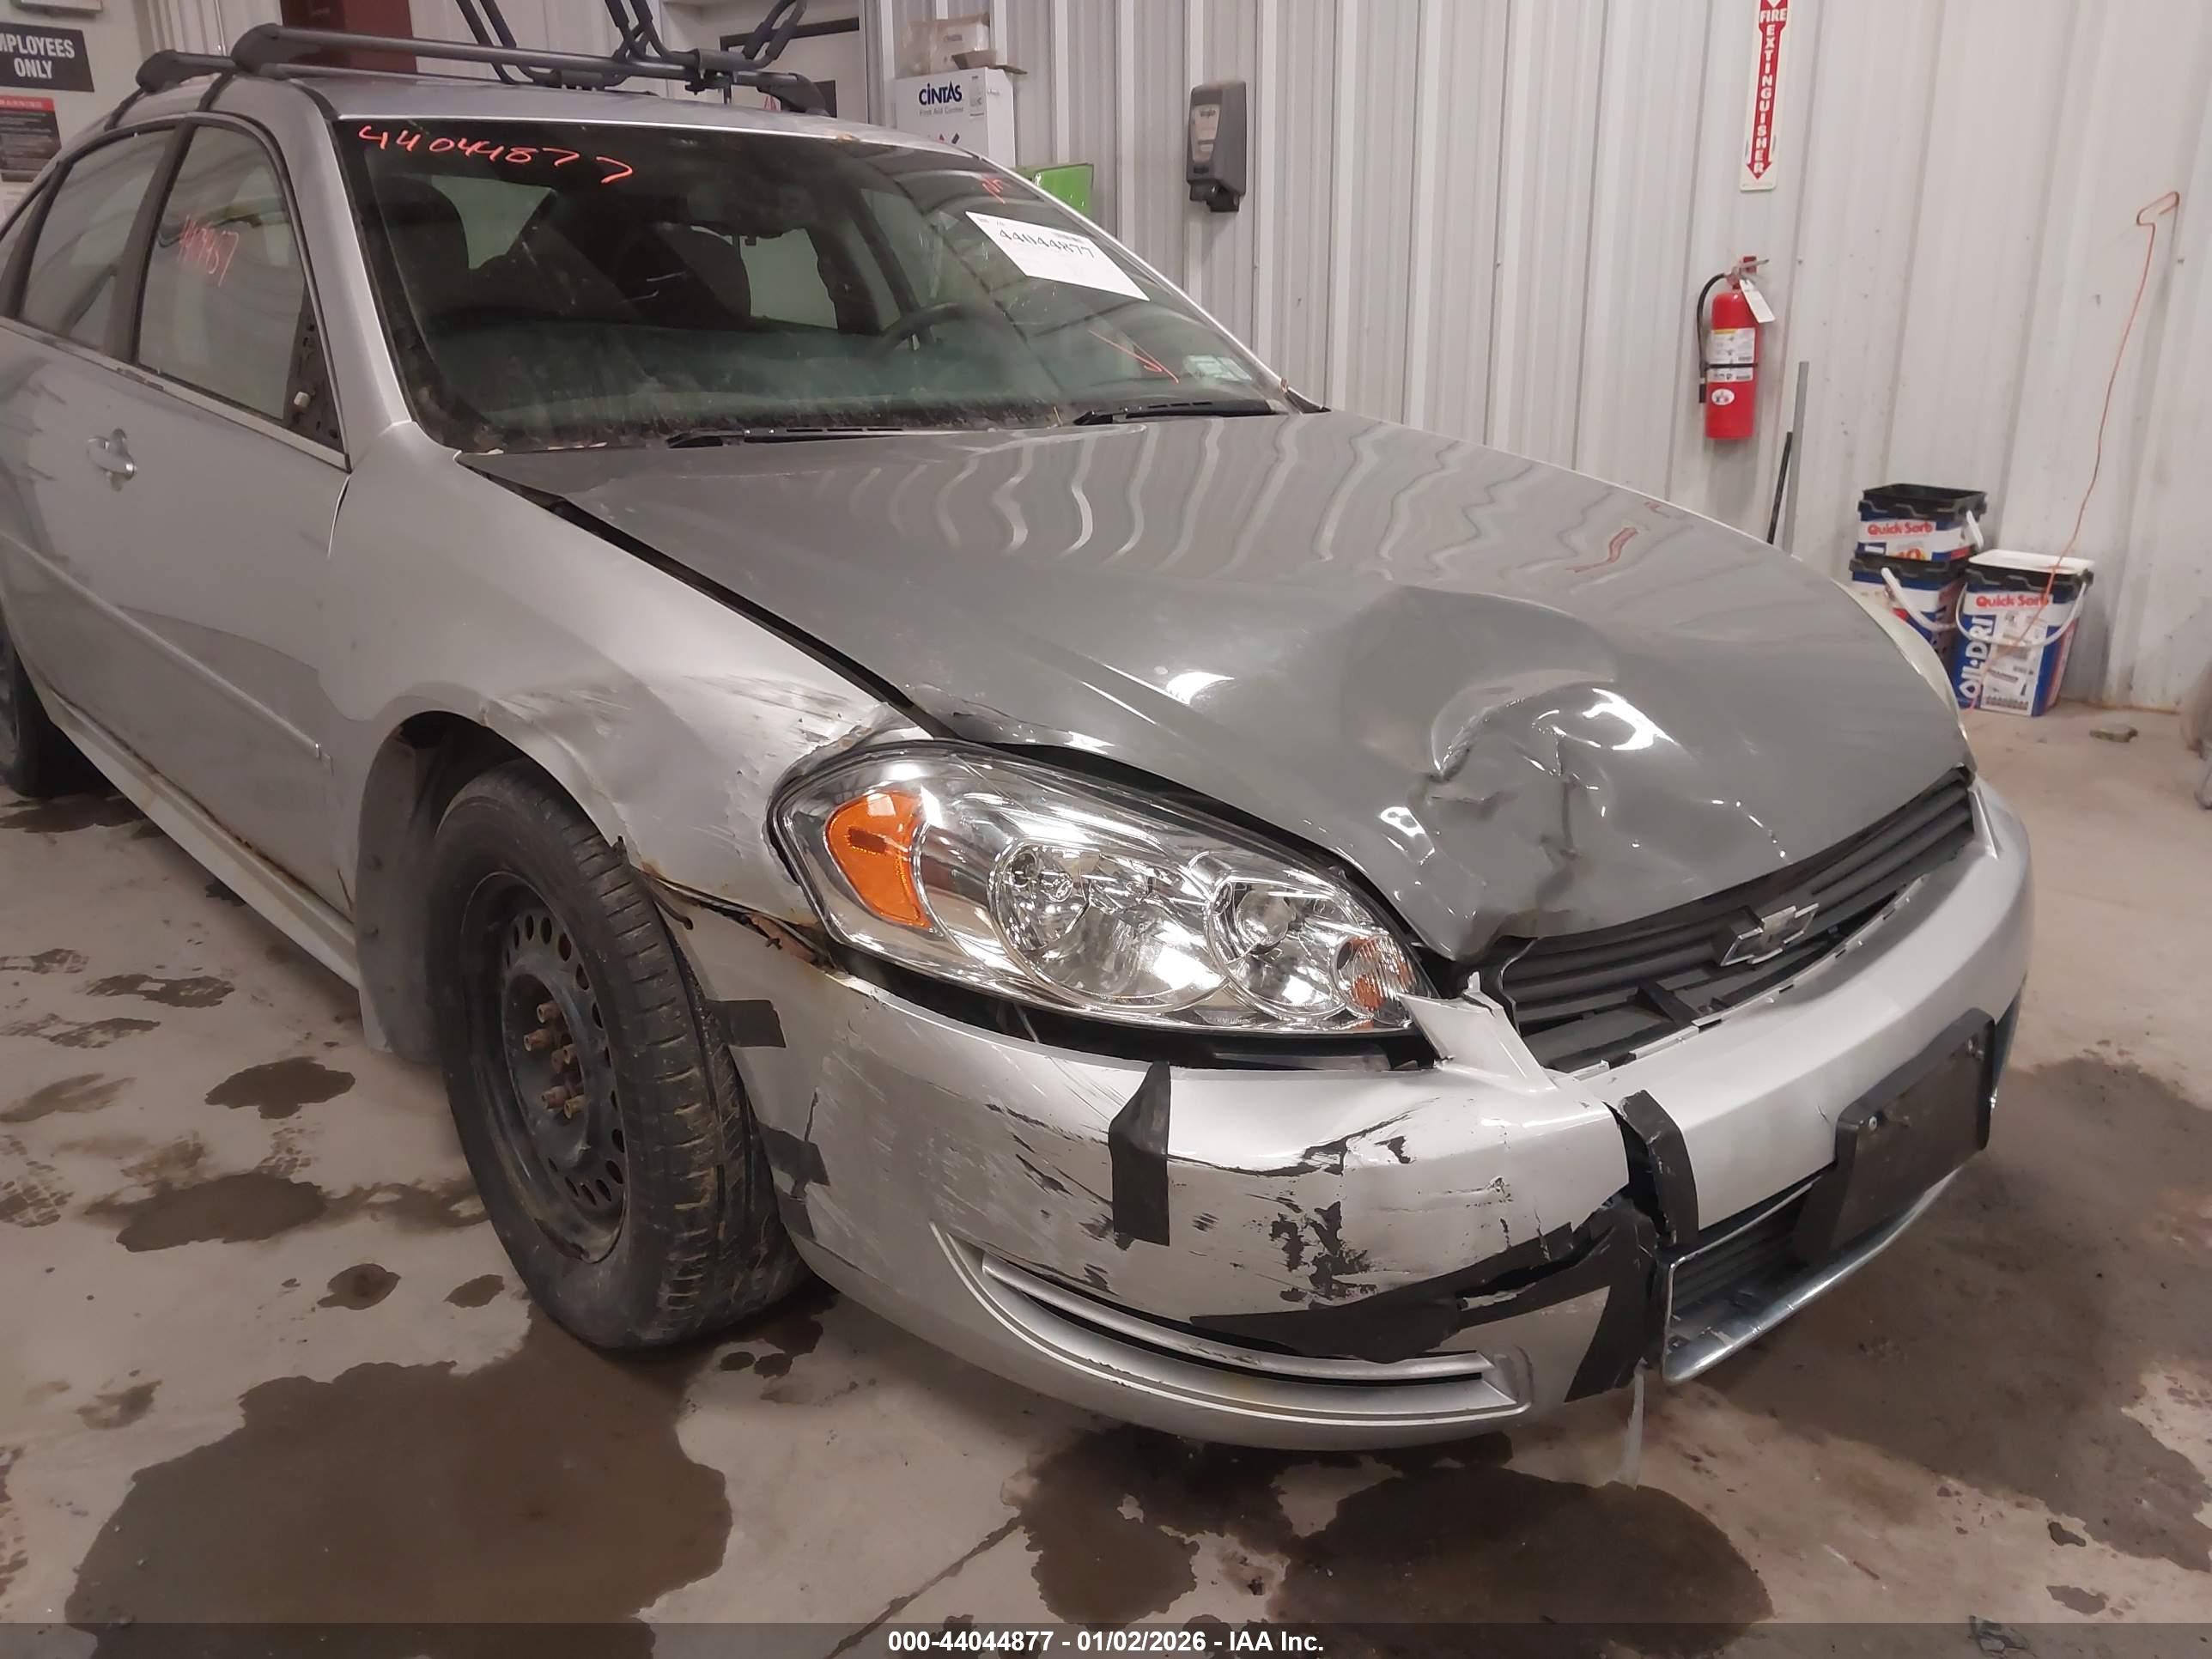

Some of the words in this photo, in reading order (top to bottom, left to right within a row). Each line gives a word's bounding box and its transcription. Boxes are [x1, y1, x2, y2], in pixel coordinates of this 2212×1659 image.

[1759, 8, 1787, 23] FIRE
[14, 58, 53, 79] ONLY
[1753, 24, 1777, 174] EXTINGUISHER
[999, 228, 1095, 258] 44044877
[1868, 522, 1902, 536] Quick
[1905, 521, 1933, 534] Sorb
[1976, 593, 2014, 607] Quick
